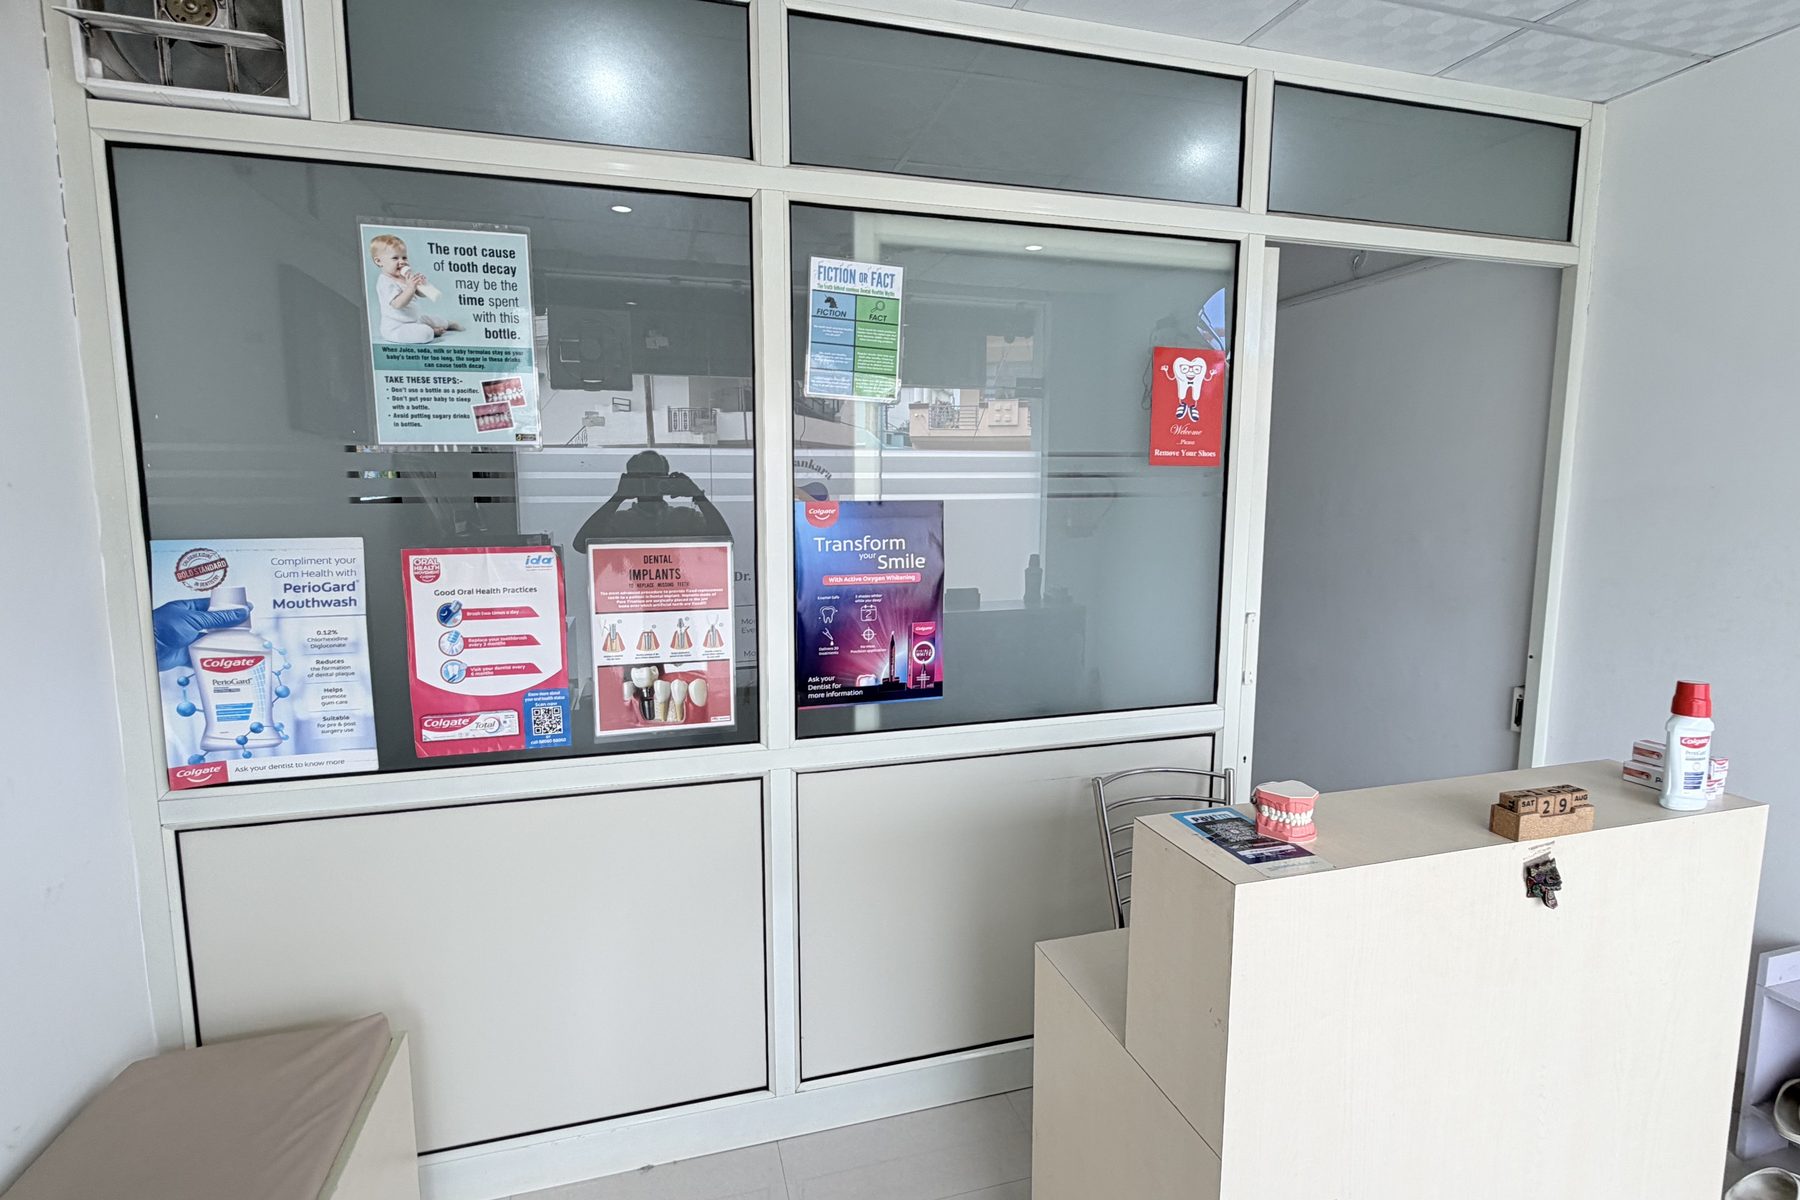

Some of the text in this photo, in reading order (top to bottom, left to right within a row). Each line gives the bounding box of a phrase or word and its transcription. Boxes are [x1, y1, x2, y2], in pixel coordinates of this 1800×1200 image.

[427, 243, 515, 258] The root cause
[434, 260, 516, 277] of tooth decay
[818, 265, 895, 288] FICTION OR FACT
[456, 279, 517, 292] may be the
[458, 294, 519, 309] time spent
[473, 311, 519, 323] with this
[817, 308, 847, 317] FICTION
[485, 328, 520, 339] bottle.
[406, 376, 430, 384] THESE
[1170, 423, 1202, 435] Welcome
[814, 535, 905, 552] Transform
[271, 557, 356, 567] Compliment your
[525, 555, 553, 565] ida
[643, 555, 672, 564] DENTAL
[878, 554, 925, 570] Smile
[194, 561, 226, 575] STANDARD
[274, 570, 299, 578] Gum
[302, 569, 333, 577] Health
[628, 568, 681, 580] IMPLANTS
[734, 571, 751, 581] Dr.
[284, 581, 356, 593] PerioGard
[503, 586, 537, 594] Practices
[273, 596, 357, 609] Mouthwash
[203, 659, 254, 668] Colgate
[826, 689, 863, 698] information
[424, 718, 470, 728] Colgate
[176, 766, 221, 778] Colgate
[269, 762, 294, 770] dentist
[1543, 800, 1550, 814] 2
[1559, 798, 1567, 812] 9
